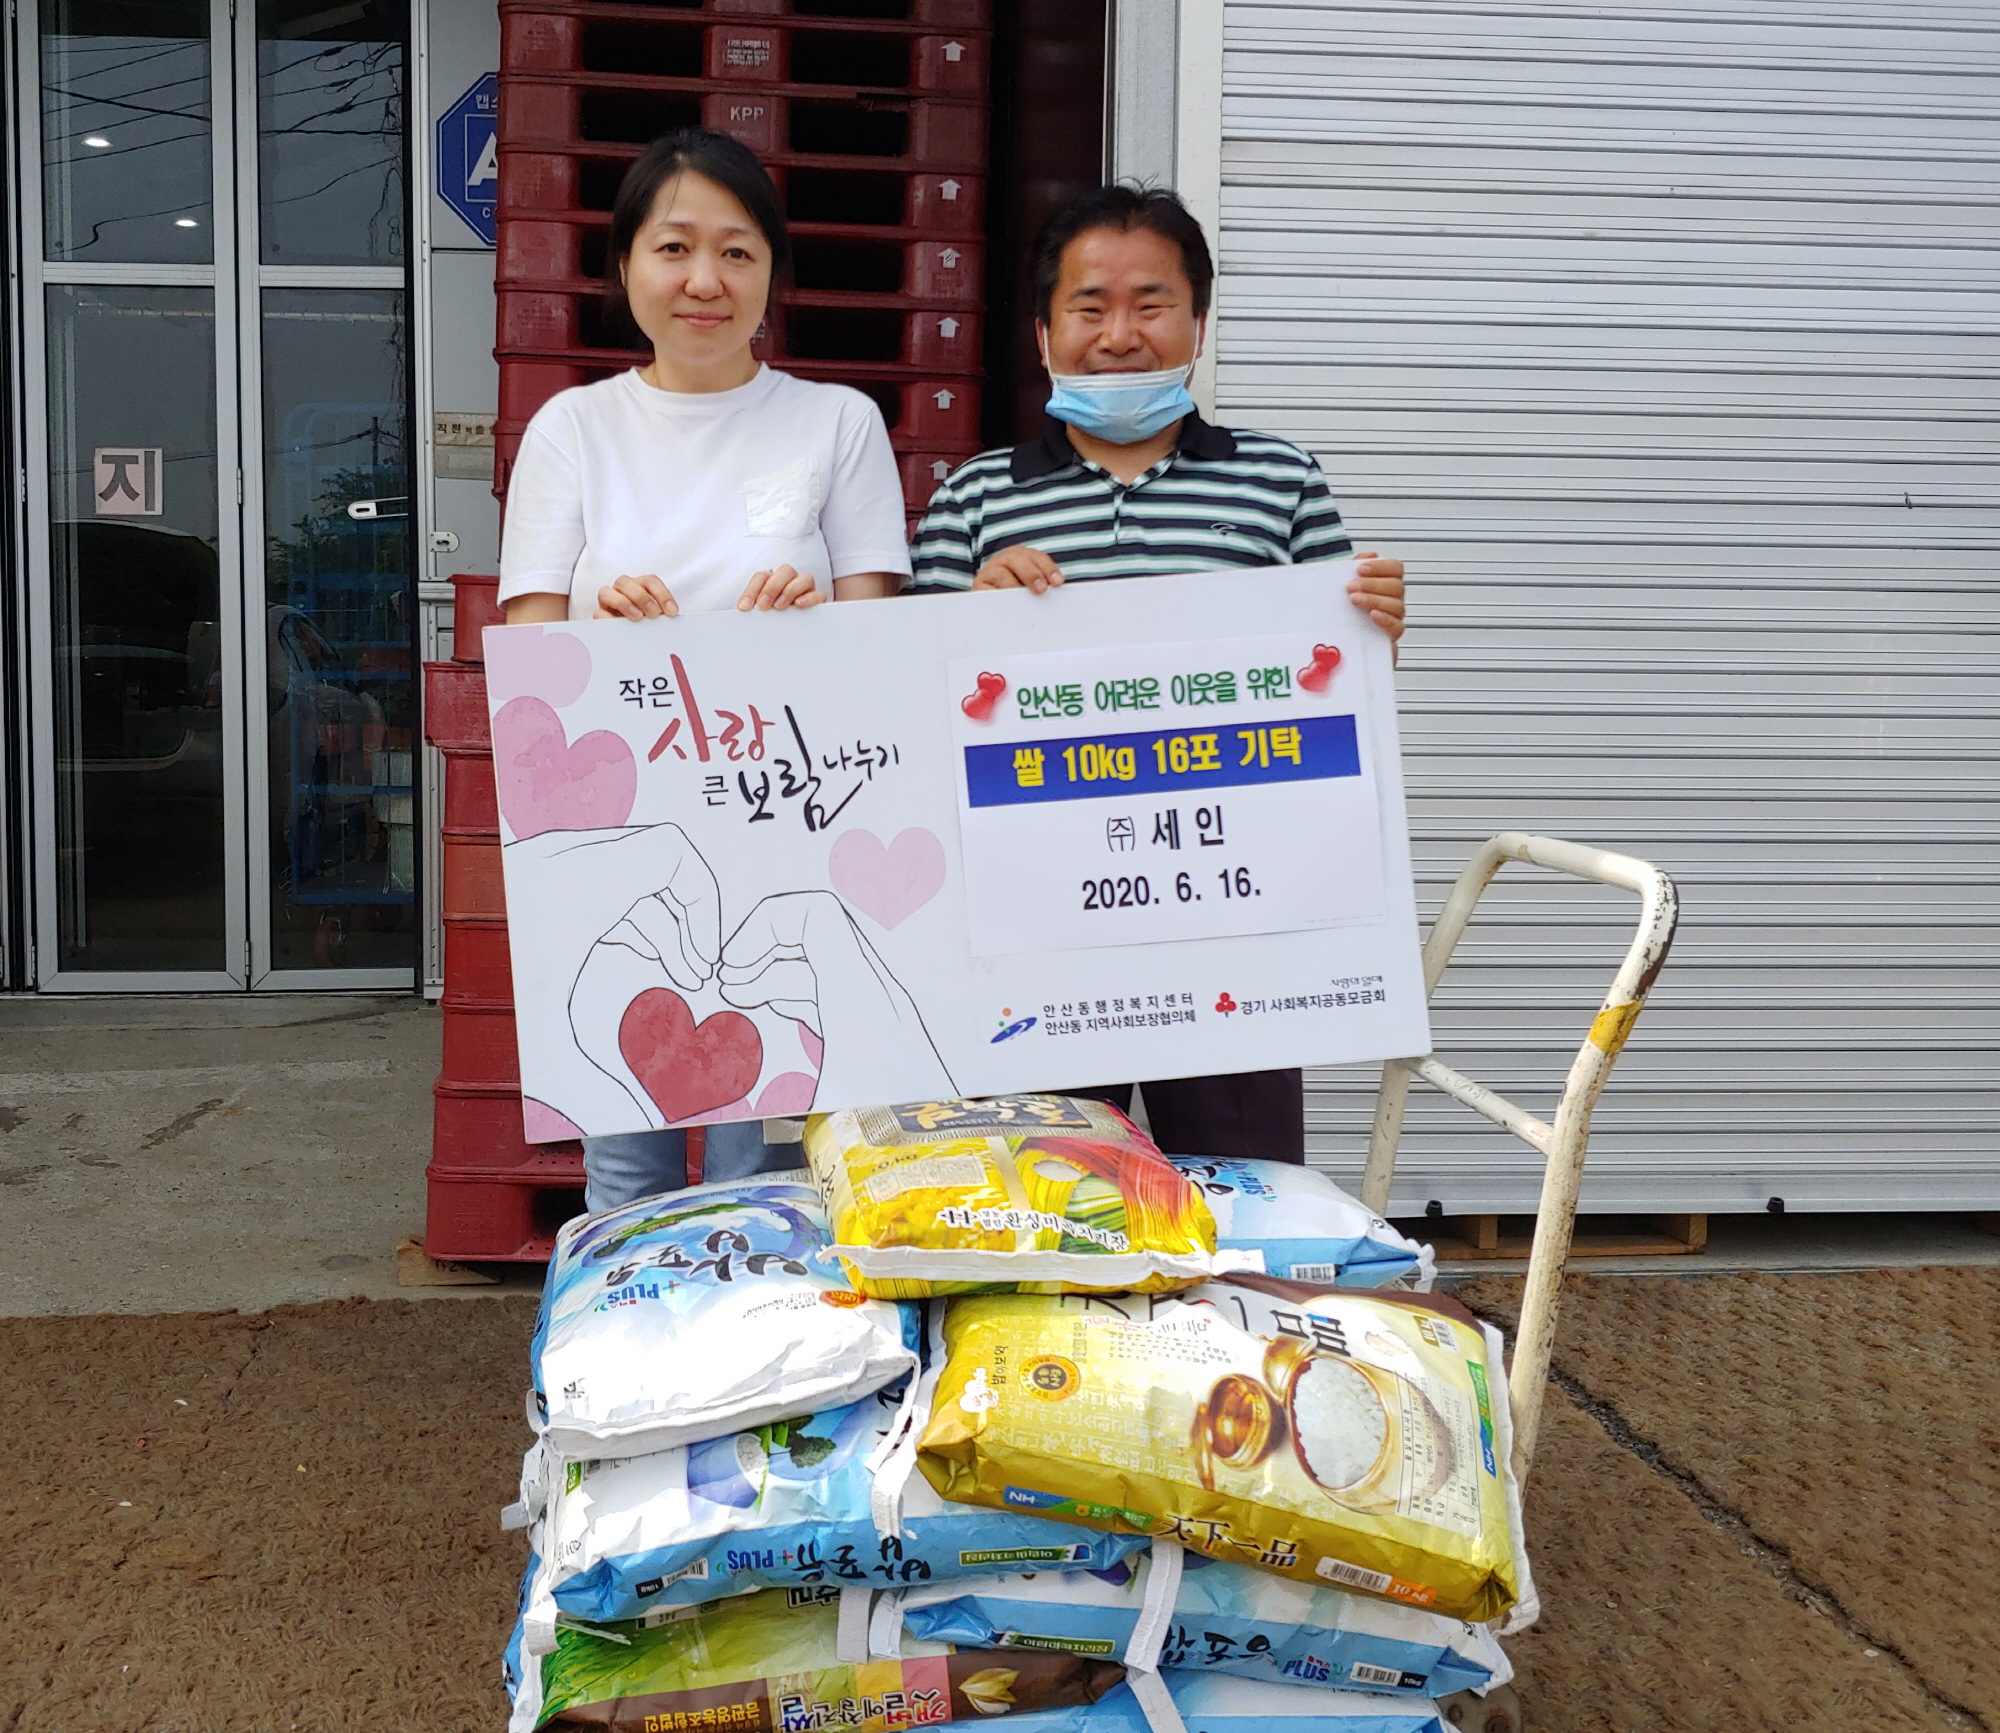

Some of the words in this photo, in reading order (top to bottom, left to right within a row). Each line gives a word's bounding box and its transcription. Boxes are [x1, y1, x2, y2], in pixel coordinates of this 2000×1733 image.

[730, 105, 764, 122] KPP
[99, 452, 156, 512] 지
[619, 676, 675, 709] 작은
[648, 653, 776, 764] 사랑
[1017, 683, 1084, 721] 안산동
[1094, 676, 1161, 713] 어려운
[1170, 670, 1237, 707] 이웃을
[1013, 747, 1045, 788] 쌀
[1062, 742, 1136, 783] 10kg
[1152, 734, 1221, 775] 16포
[1238, 726, 1302, 768] 기탁
[701, 775, 730, 807] 큰
[823, 739, 900, 782] 나누기
[1082, 876, 1160, 911] 2020.
[1175, 871, 1201, 902] 6.
[1218, 867, 1261, 899] 16.
[1239, 999, 1266, 1016] 경기
[1270, 989, 1386, 1012] 사회복지공동모금회
[1044, 1019, 1082, 1036] 안산동
[1086, 1009, 1197, 1033] 지역사회보장협의체
[607, 1282, 659, 1306] PLUS
[1008, 1490, 1036, 1505] NH
[1156, 1514, 1299, 1568] 天下一品
[727, 1549, 774, 1572] PLUS
[1282, 1659, 1331, 1683] PLUS
[643, 1702, 761, 1733] 금판영농조합법인
